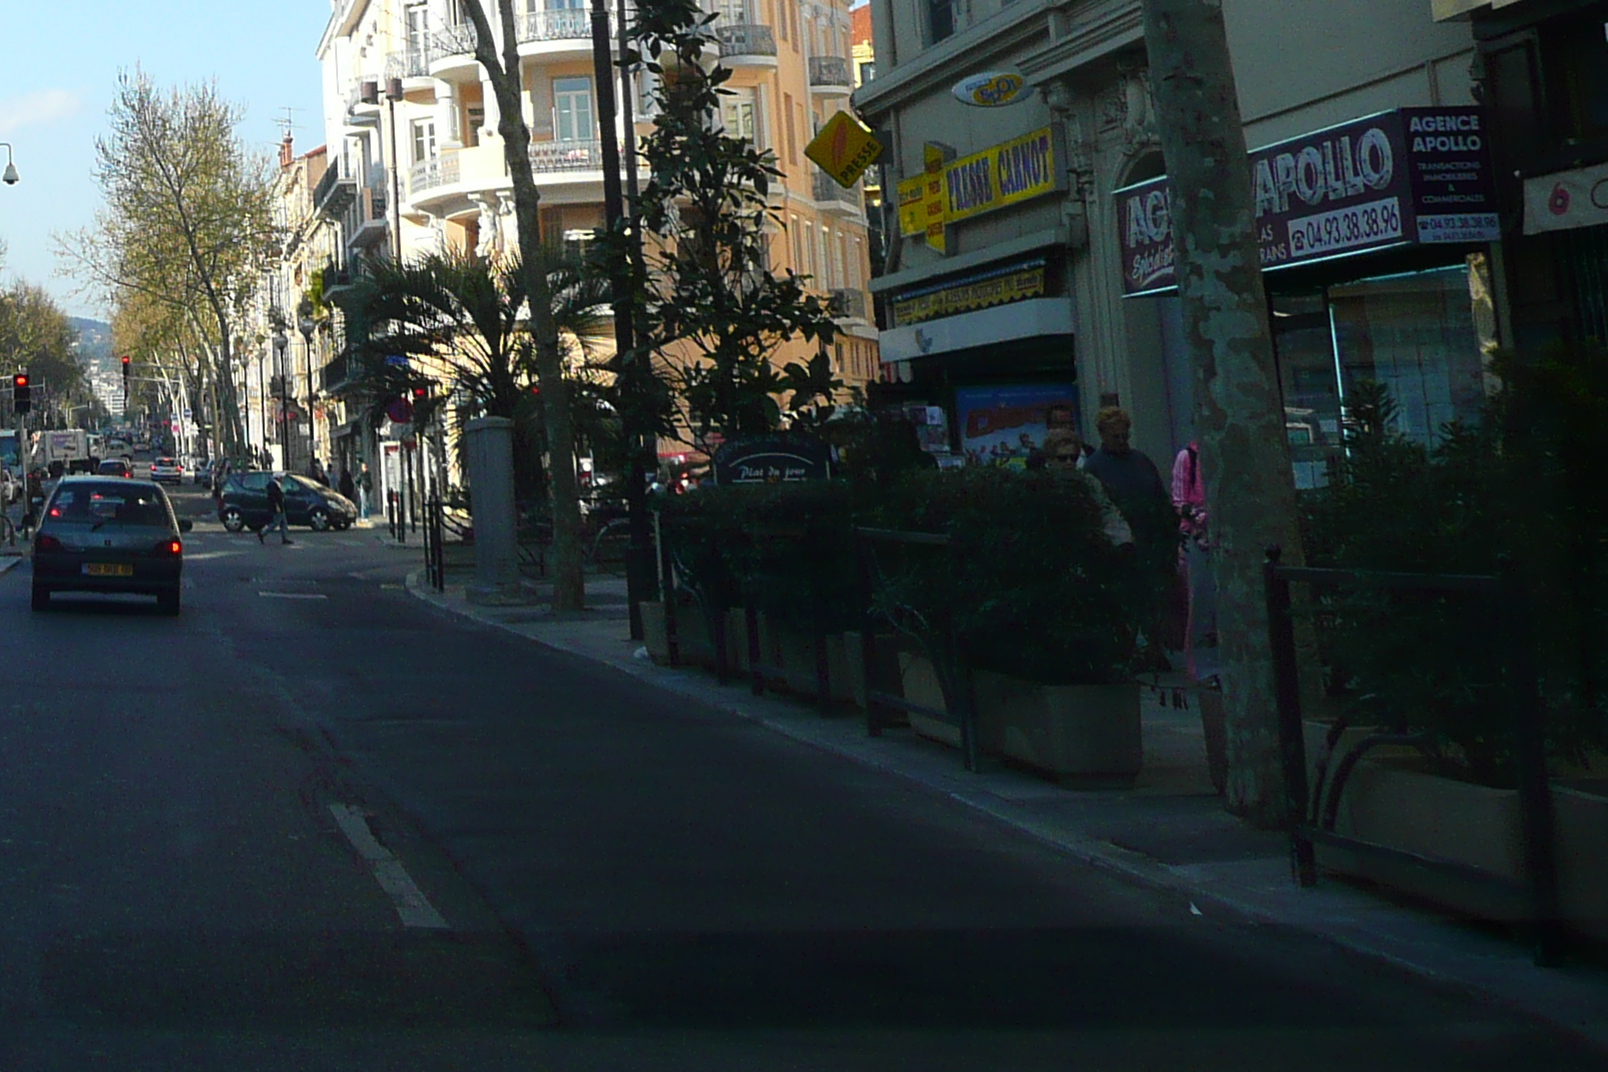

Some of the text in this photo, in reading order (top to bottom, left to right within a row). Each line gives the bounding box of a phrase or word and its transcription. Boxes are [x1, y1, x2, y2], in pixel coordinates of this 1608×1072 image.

[1410, 115, 1479, 132] AGENCE
[1412, 134, 1481, 152] APOLLO
[840, 140, 877, 182] PRESSE
[946, 134, 1051, 213] PRESSE CARNOT
[1125, 127, 1393, 248] AG APOLLO
[1421, 194, 1486, 204] COMMERCIALES
[1306, 203, 1399, 249] 04.93.38.38.96
[739, 465, 764, 479] Plat
